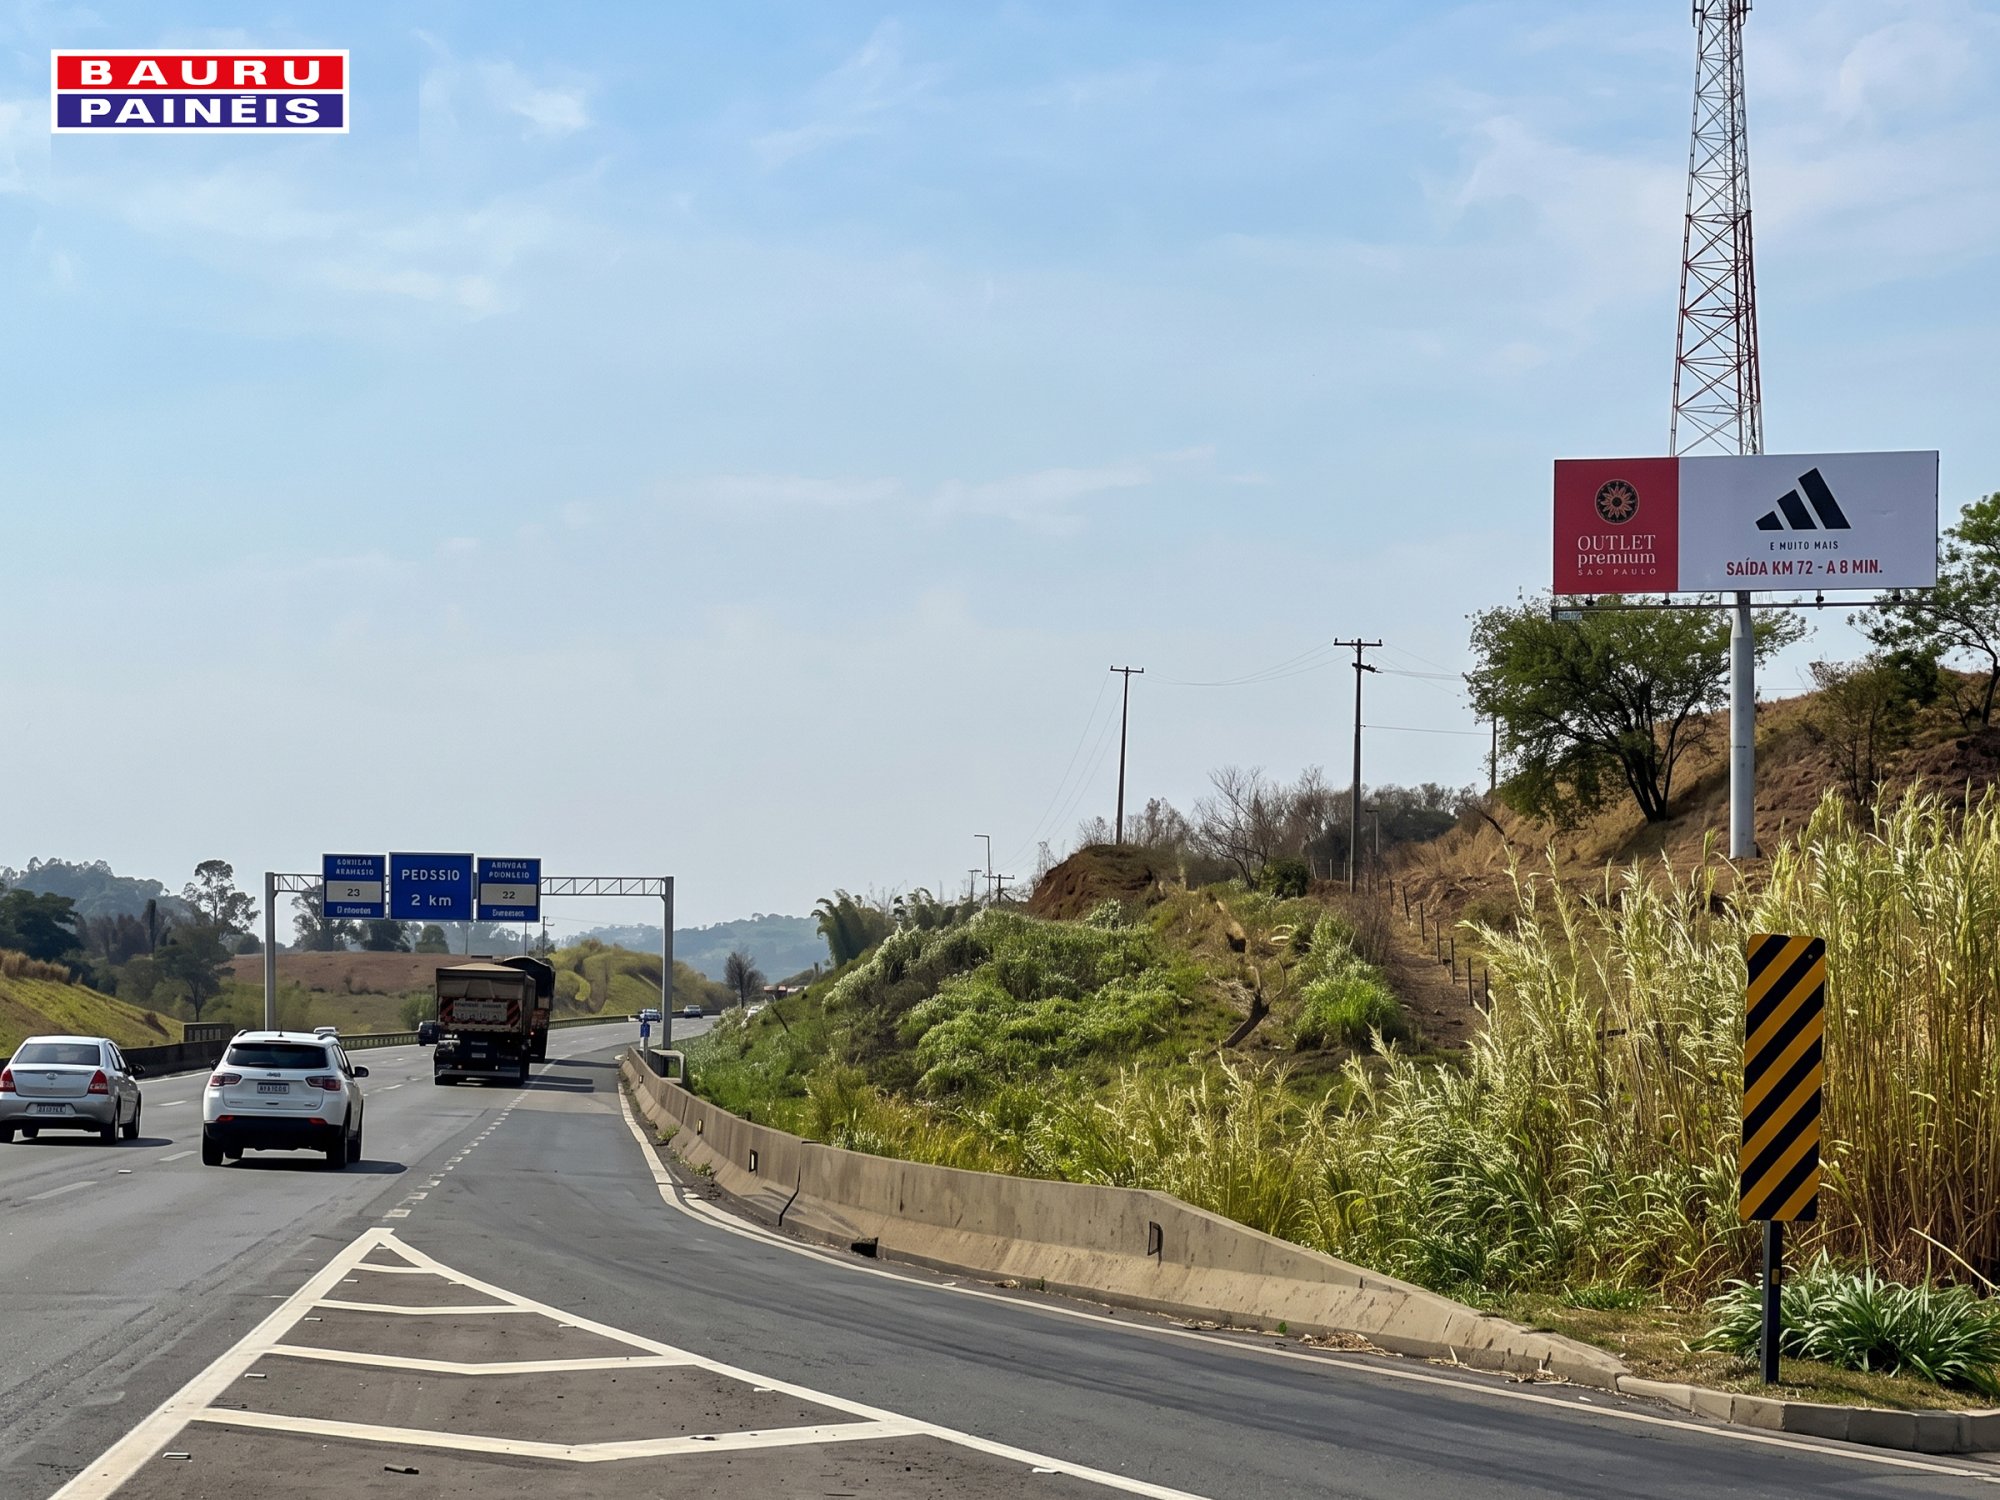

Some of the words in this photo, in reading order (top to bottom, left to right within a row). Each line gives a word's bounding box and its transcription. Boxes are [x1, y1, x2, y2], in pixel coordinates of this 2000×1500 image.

[1577, 534, 1656, 551] OUTLET
[1769, 542, 1775, 551] E
[1779, 541, 1810, 551] MUITO
[1814, 540, 1839, 550] MAIS
[1577, 551, 1656, 568] premium
[1613, 567, 1656, 576] PAULO
[1726, 557, 1768, 576] SAÍDA
[1772, 561, 1793, 575] KM
[1797, 560, 1813, 575] 72
[1826, 560, 1836, 574] A
[1839, 560, 1848, 574] 8
[1852, 559, 1883, 574] MIN.
[347, 888, 361, 897] 23
[502, 891, 516, 900] 22
[411, 893, 421, 906] 2
[429, 894, 452, 906] km
